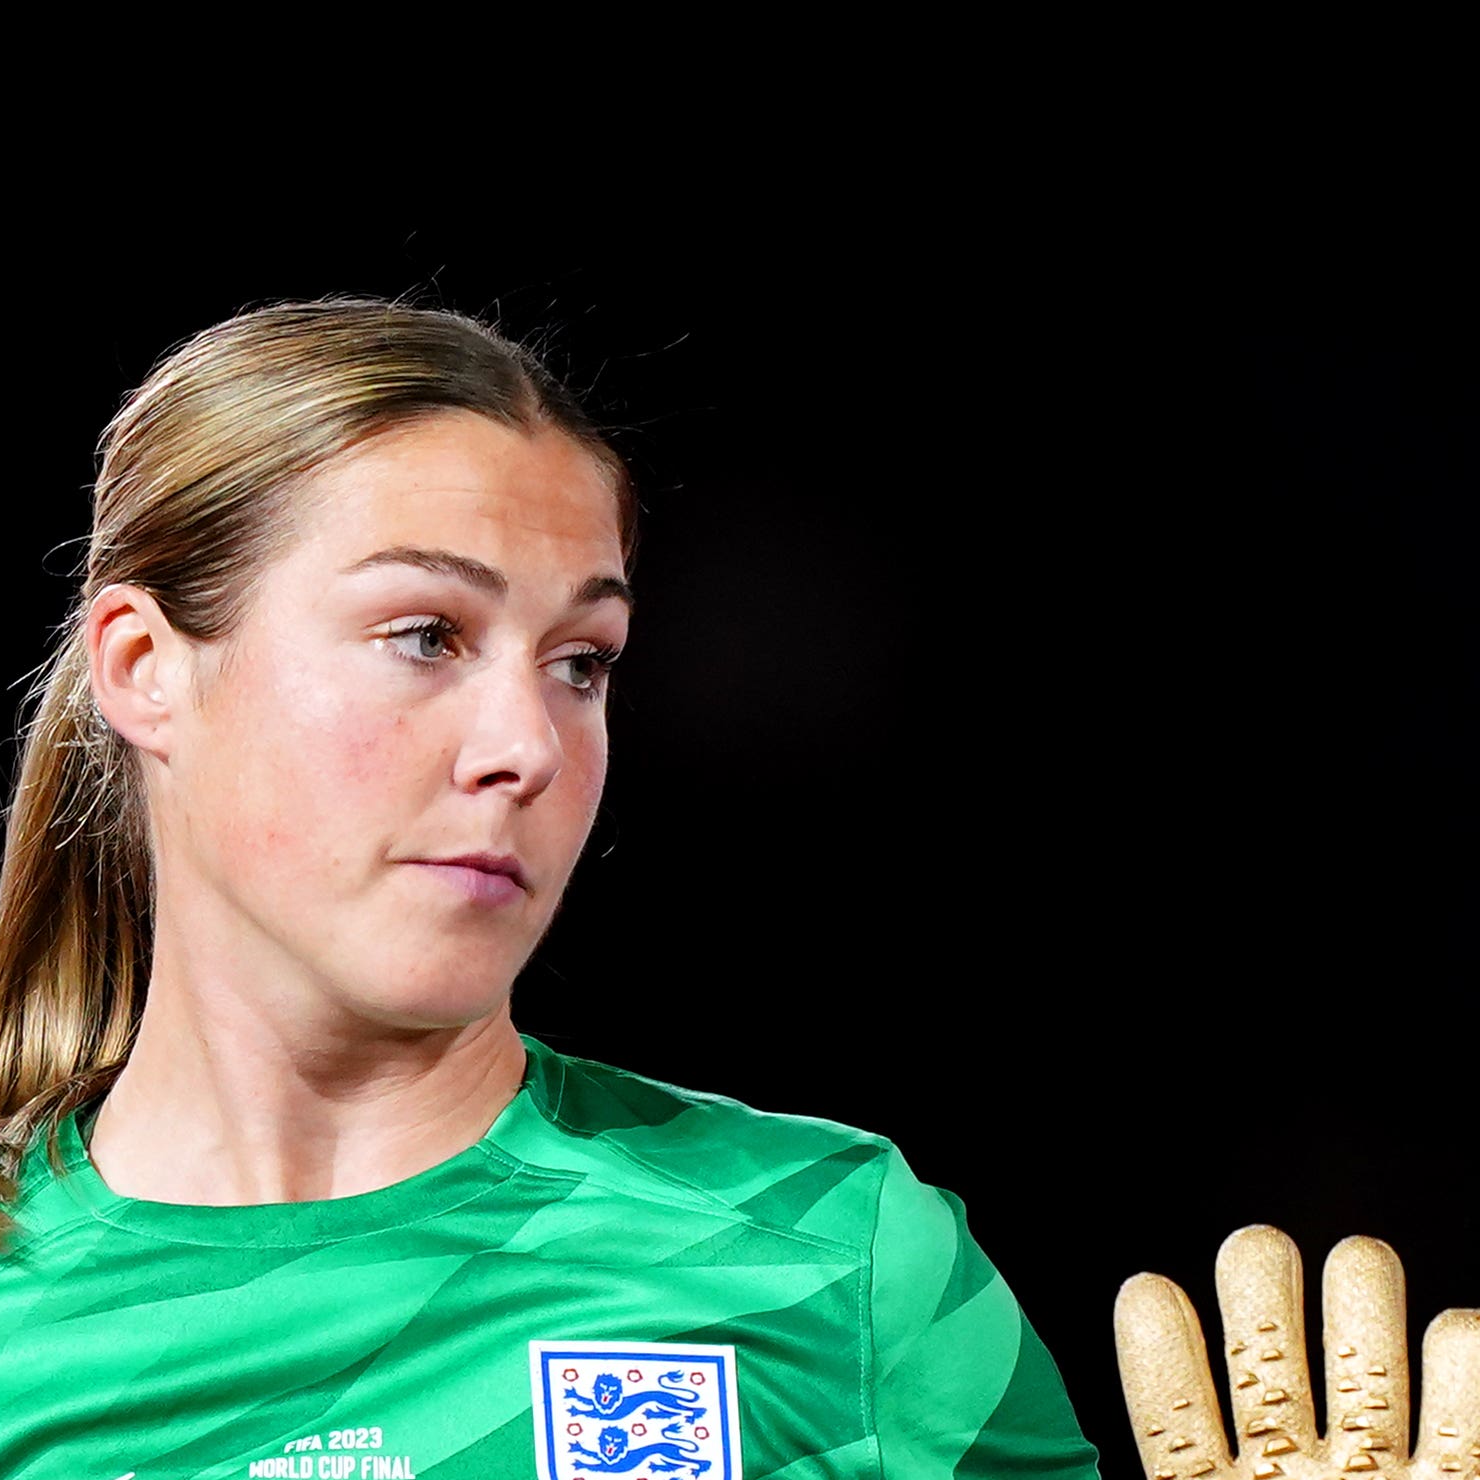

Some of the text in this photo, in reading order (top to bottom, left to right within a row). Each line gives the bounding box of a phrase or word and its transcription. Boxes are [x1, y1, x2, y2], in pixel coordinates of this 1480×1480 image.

[284, 1427, 382, 1454] FIFA 2023
[249, 1456, 416, 1480] WORLD CUP FINAL
